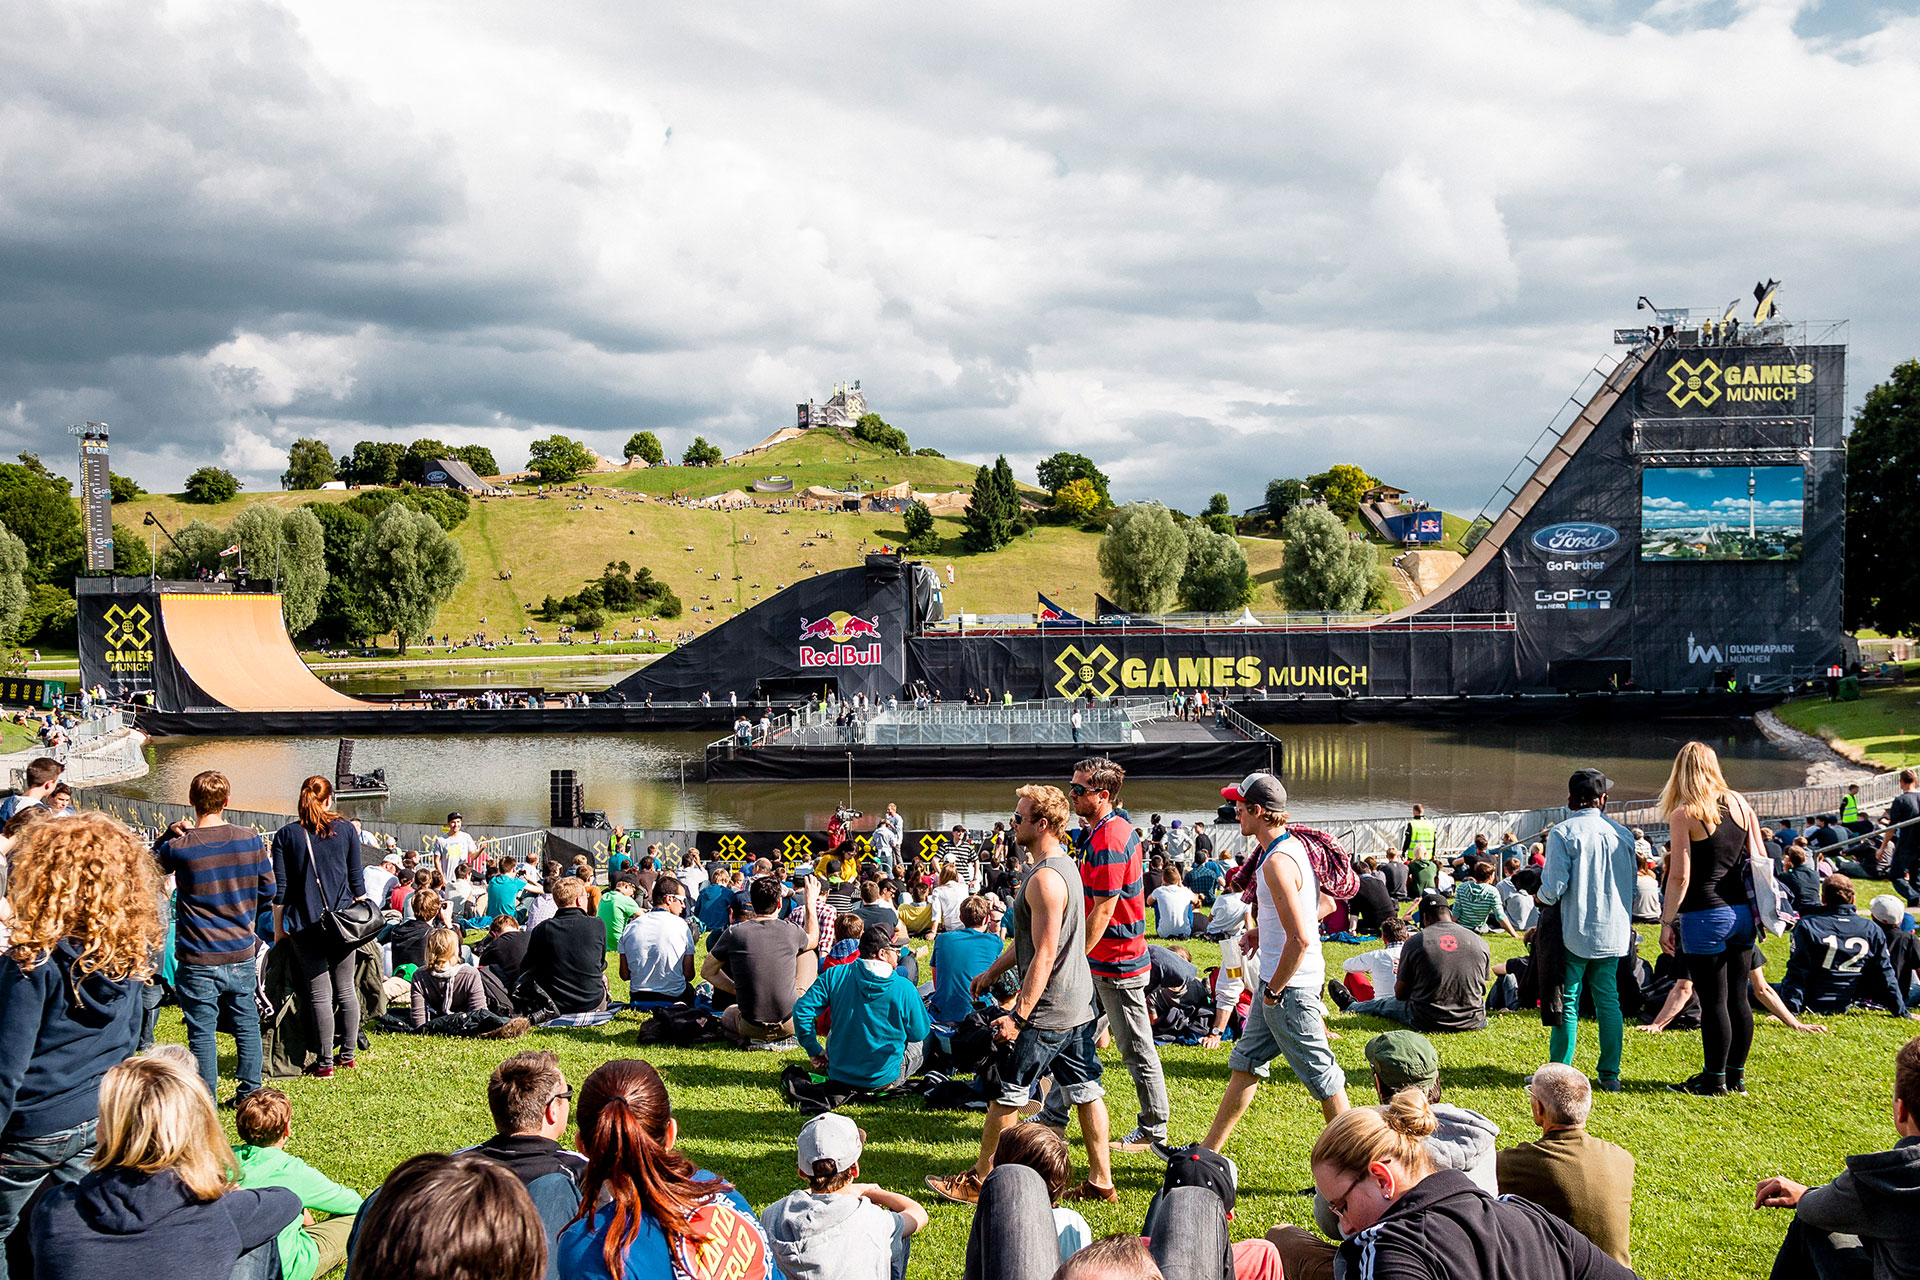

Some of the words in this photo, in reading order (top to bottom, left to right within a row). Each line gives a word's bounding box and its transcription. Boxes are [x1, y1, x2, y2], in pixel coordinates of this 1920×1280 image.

[1724, 364, 1814, 385] GAMES
[1726, 386, 1797, 402] MUNICH
[1548, 527, 1601, 549] Ford
[1546, 560, 1563, 571] Go
[1564, 560, 1605, 571] Further
[1534, 588, 1612, 602] GoPro
[105, 650, 154, 663] GAMES
[800, 644, 840, 667] Red
[842, 643, 882, 666] Bull
[1729, 644, 1795, 654] OLYMPIAPARK
[1729, 654, 1771, 663] MÜNCHEN
[111, 662, 149, 672] MUNICH
[1120, 656, 1262, 689] GAMES
[1268, 665, 1368, 687] MUNICH
[1821, 934, 1870, 973] 12
